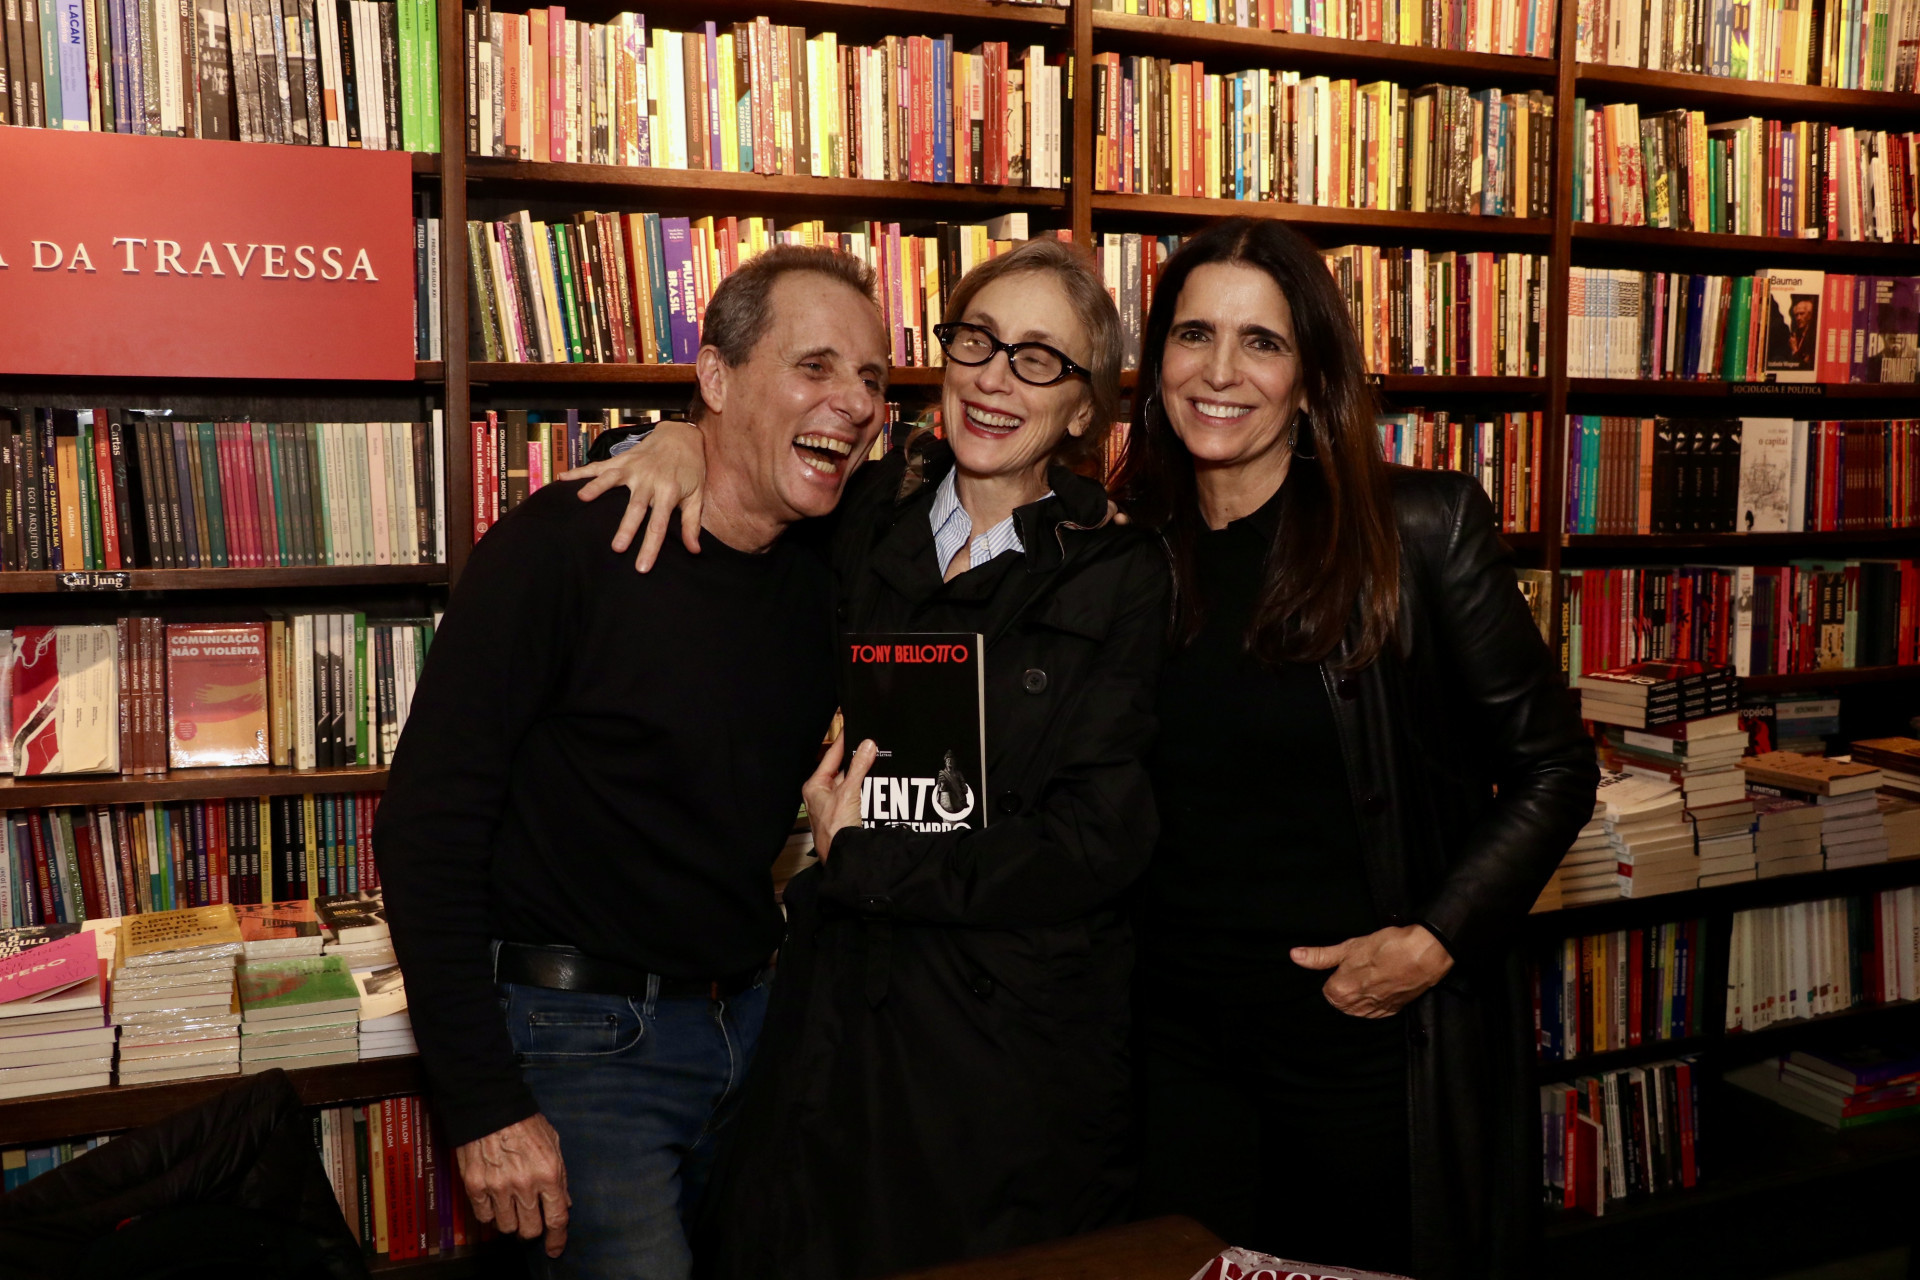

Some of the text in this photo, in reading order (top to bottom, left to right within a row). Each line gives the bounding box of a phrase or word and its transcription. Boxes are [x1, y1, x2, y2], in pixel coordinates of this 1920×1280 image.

[68, 4, 81, 45] LACAN
[510, 67, 518, 112] evidências
[1598, 146, 1606, 205] POLICIAMENTO
[30, 236, 379, 281] DA TRAVESSA
[667, 270, 680, 314] BRASIL
[682, 260, 697, 323] MULHERES
[1568, 277, 1577, 316] BAUMAN
[1771, 276, 1802, 286] Bauman
[1630, 282, 1639, 317] BAUMAN
[913, 326, 922, 367] BADERNA
[1881, 358, 1917, 383] FERNANDES
[1733, 385, 1822, 394] SOCIOLOGIA E POLÍTICA
[99, 428, 107, 457] GREENE
[110, 423, 122, 456] Cartas
[476, 427, 484, 448] Contra
[1765, 438, 1788, 448] capital
[48, 465, 56, 484] JUNG
[52, 518, 58, 526] DA
[477, 484, 485, 519] neoliberal
[29, 512, 39, 559] ARQUÉTIPO
[67, 506, 75, 537] ALQUIMIA
[174, 519, 182, 542] ROWLAND
[63, 574, 123, 588] Carl Jung
[171, 634, 260, 646] COMUNICAÇÃO
[171, 646, 260, 657] NÃO VIOLENTA
[851, 644, 968, 663] TONY BELLOTTO
